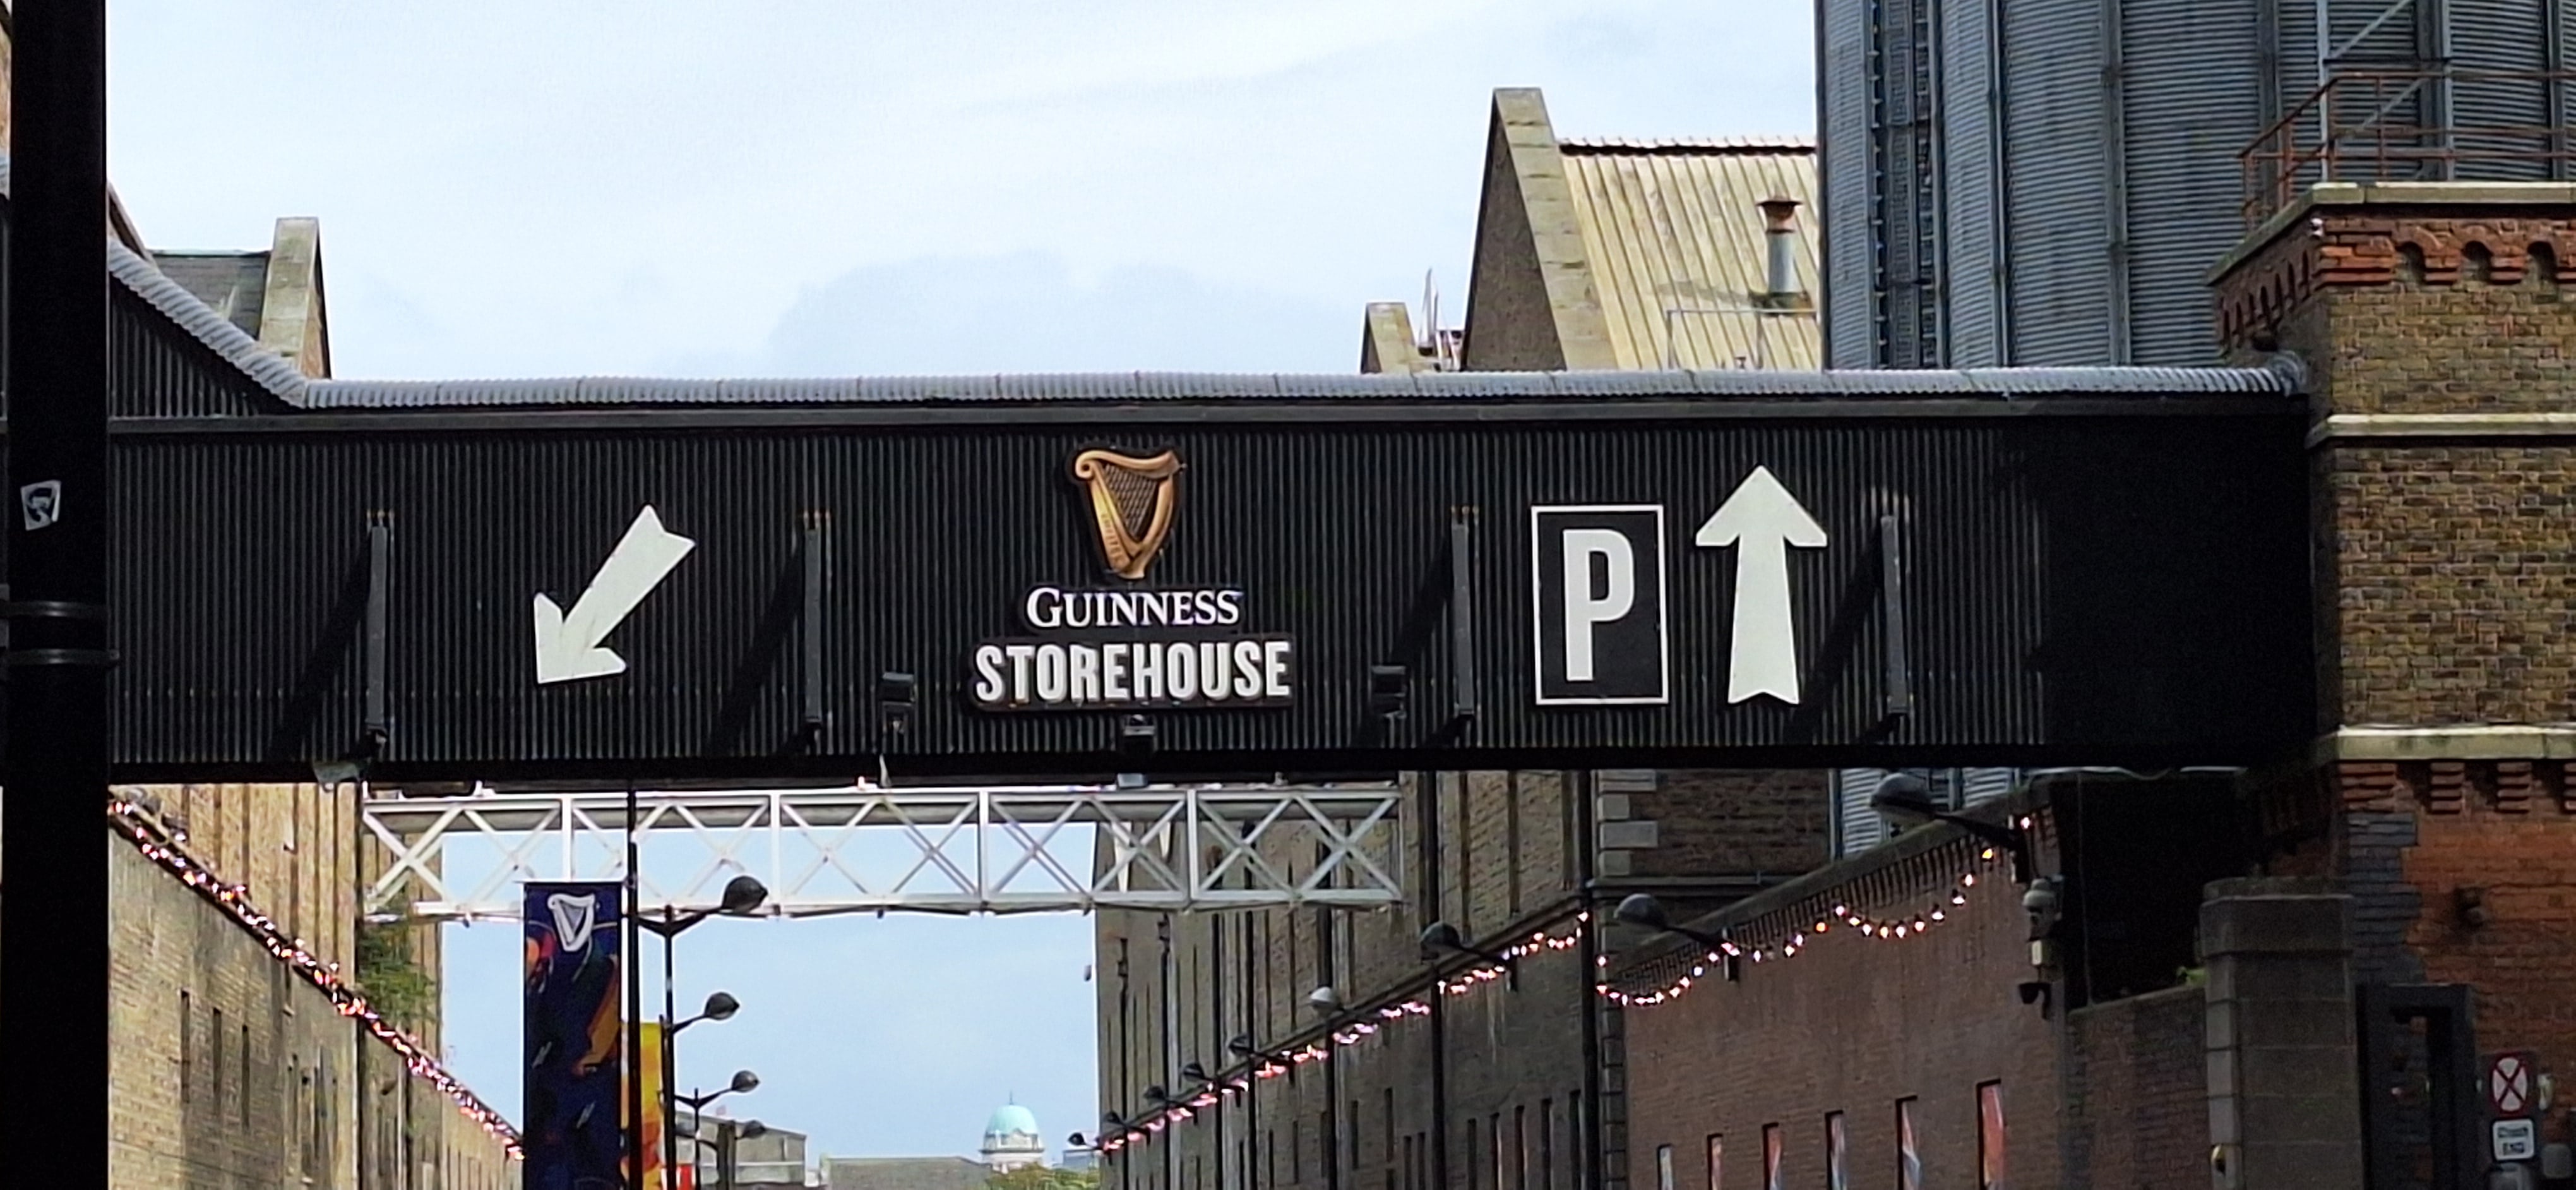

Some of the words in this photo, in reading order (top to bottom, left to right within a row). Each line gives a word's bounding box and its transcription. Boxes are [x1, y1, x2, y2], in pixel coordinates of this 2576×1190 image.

[1027, 587, 1242, 627] GUINNESS
[1563, 529, 1635, 681] P
[975, 640, 1291, 702] STOREHOUSE
